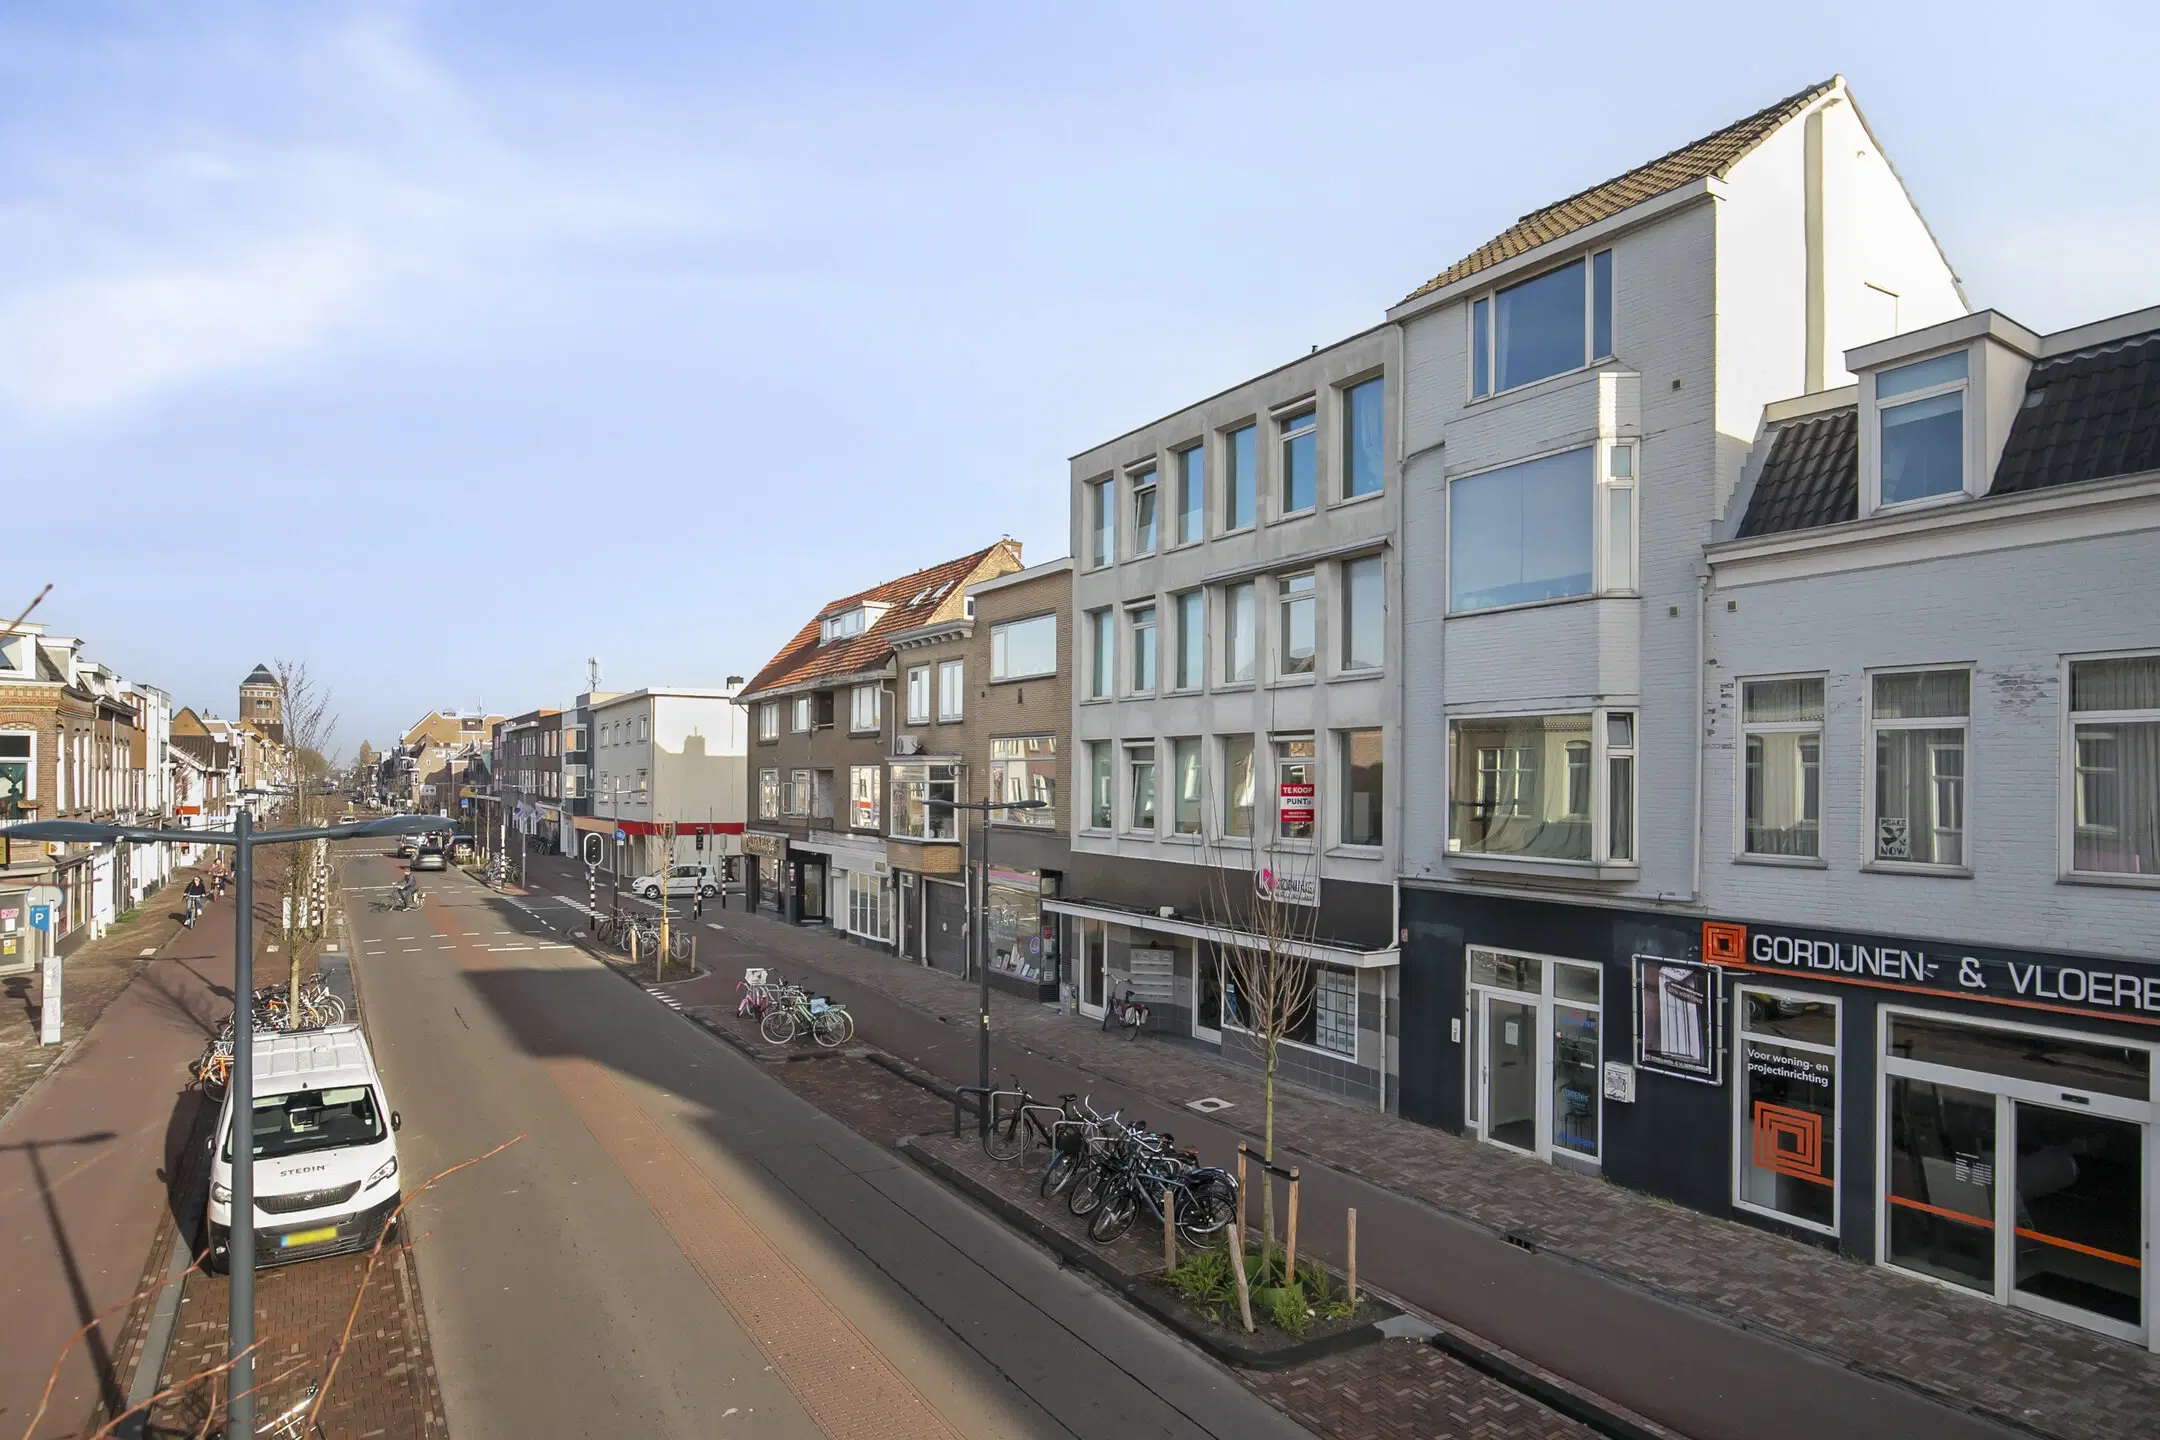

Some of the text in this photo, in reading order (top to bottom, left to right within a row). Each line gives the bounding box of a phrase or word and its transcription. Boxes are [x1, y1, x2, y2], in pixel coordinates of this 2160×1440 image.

[1881, 818, 1907, 827] PEACE
[1880, 846, 1906, 856] NOW
[35, 912, 44, 924] P
[1958, 956, 1988, 989] &
[2007, 961, 2160, 1012] VLOERE
[1747, 1047, 1829, 1072] Voor woning- en
[1747, 1062, 1829, 1088] projectinrichting
[280, 1165, 325, 1177] STEDIN
